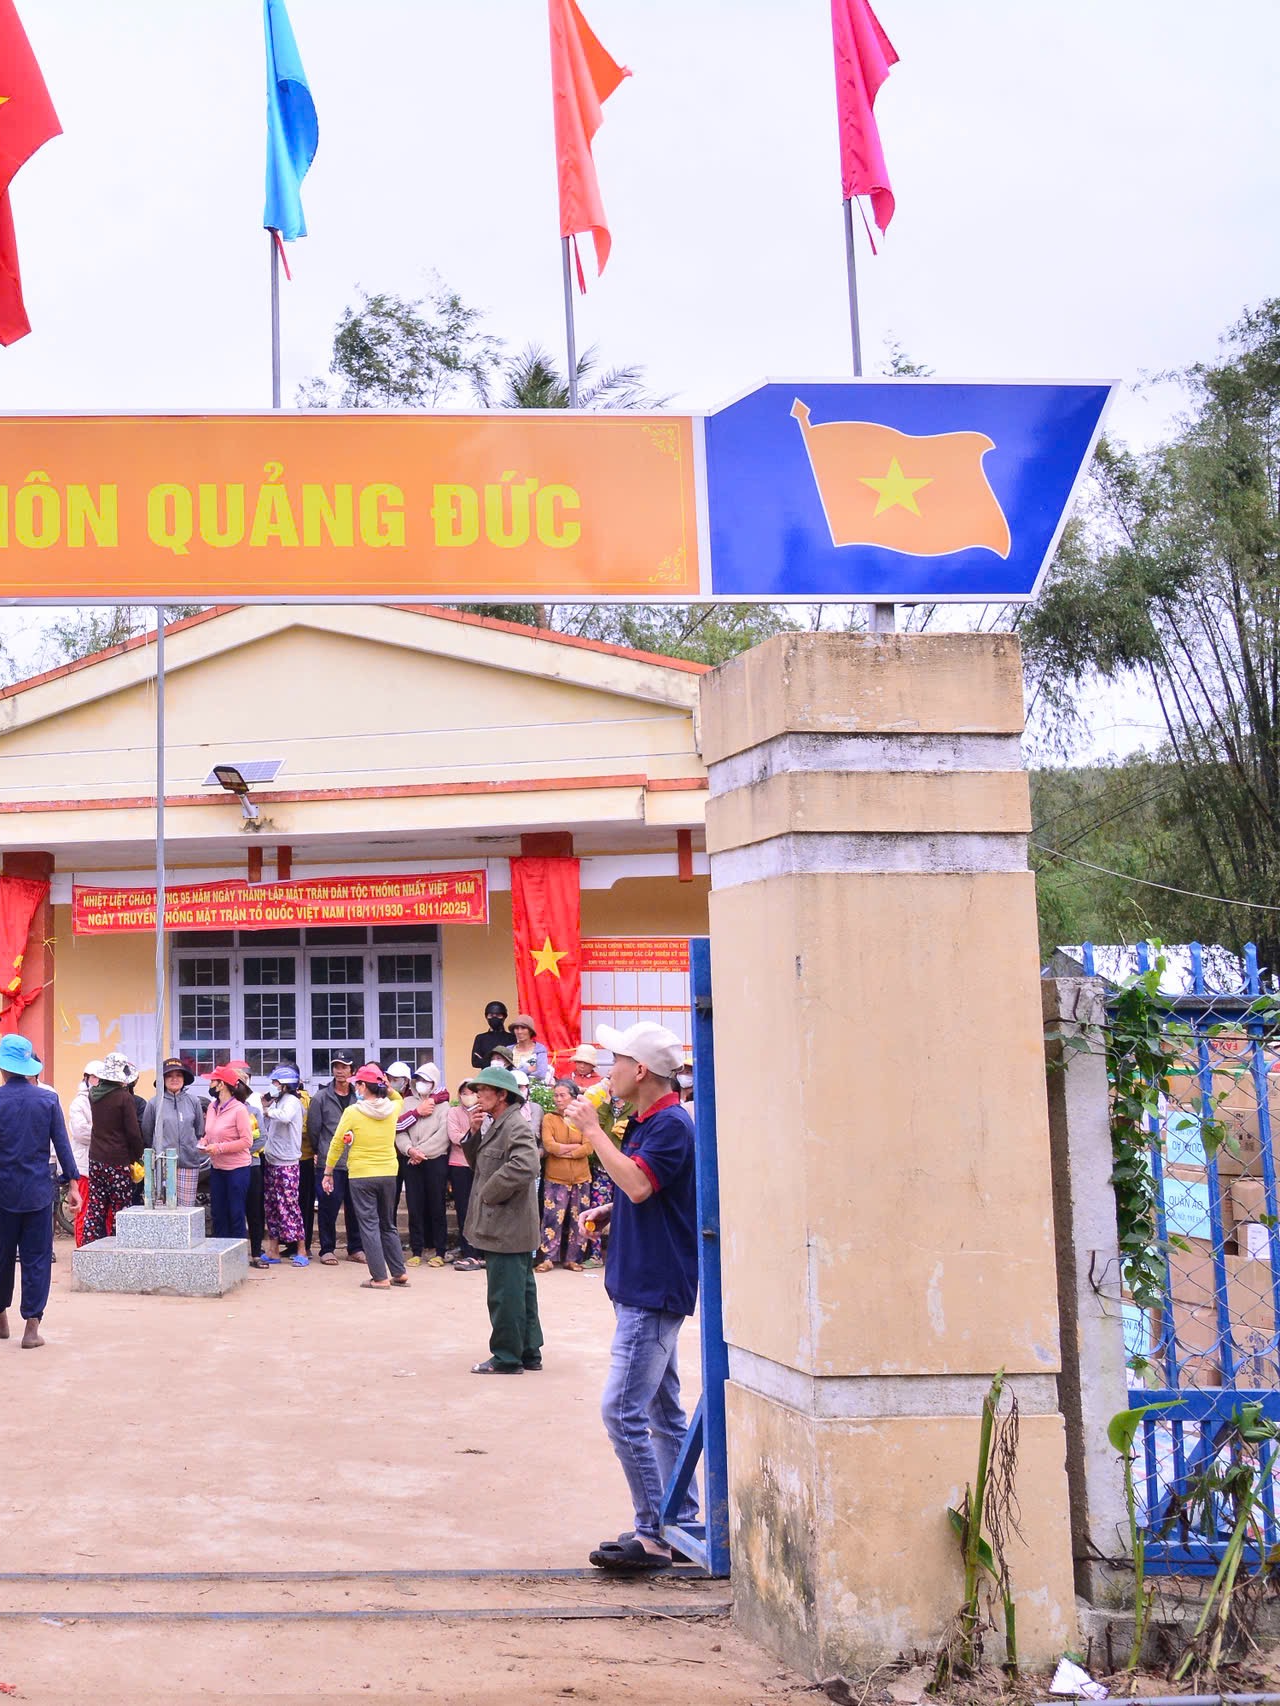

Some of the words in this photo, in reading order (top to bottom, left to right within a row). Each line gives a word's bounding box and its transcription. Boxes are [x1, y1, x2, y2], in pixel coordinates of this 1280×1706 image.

[147, 461, 405, 555] QUẢNG
[431, 470, 581, 548] ĐỨC
[83, 891, 107, 909] NHIỆT
[109, 891, 127, 909] LIỆT
[128, 891, 152, 906] CHÀO
[180, 892, 190, 904] 95
[192, 889, 210, 903] NĂM
[212, 888, 235, 902] NGÀY
[237, 887, 266, 901] THÀNH
[268, 886, 284, 903] LẬP
[305, 885, 329, 902] TRẬN
[331, 884, 348, 899] DÂN
[350, 883, 368, 901] TỘC
[370, 880, 400, 898] THỐNG
[402, 879, 426, 897] NHẤT
[428, 880, 448, 898] VIỆT
[455, 881, 475, 894] NAM
[87, 911, 114, 926] NGÀY
[117, 908, 157, 925] TRUYỀN
[163, 906, 194, 923] HỐNG
[195, 907, 217, 925] MẶT
[219, 905, 246, 925] TRẬN
[248, 902, 263, 921] TỔ
[265, 902, 294, 920] QUỐC
[296, 903, 320, 922] VIỆT
[322, 905, 345, 919] NAM
[347, 903, 404, 920] (18/11/1930
[413, 901, 470, 917] 18/11/2025)
